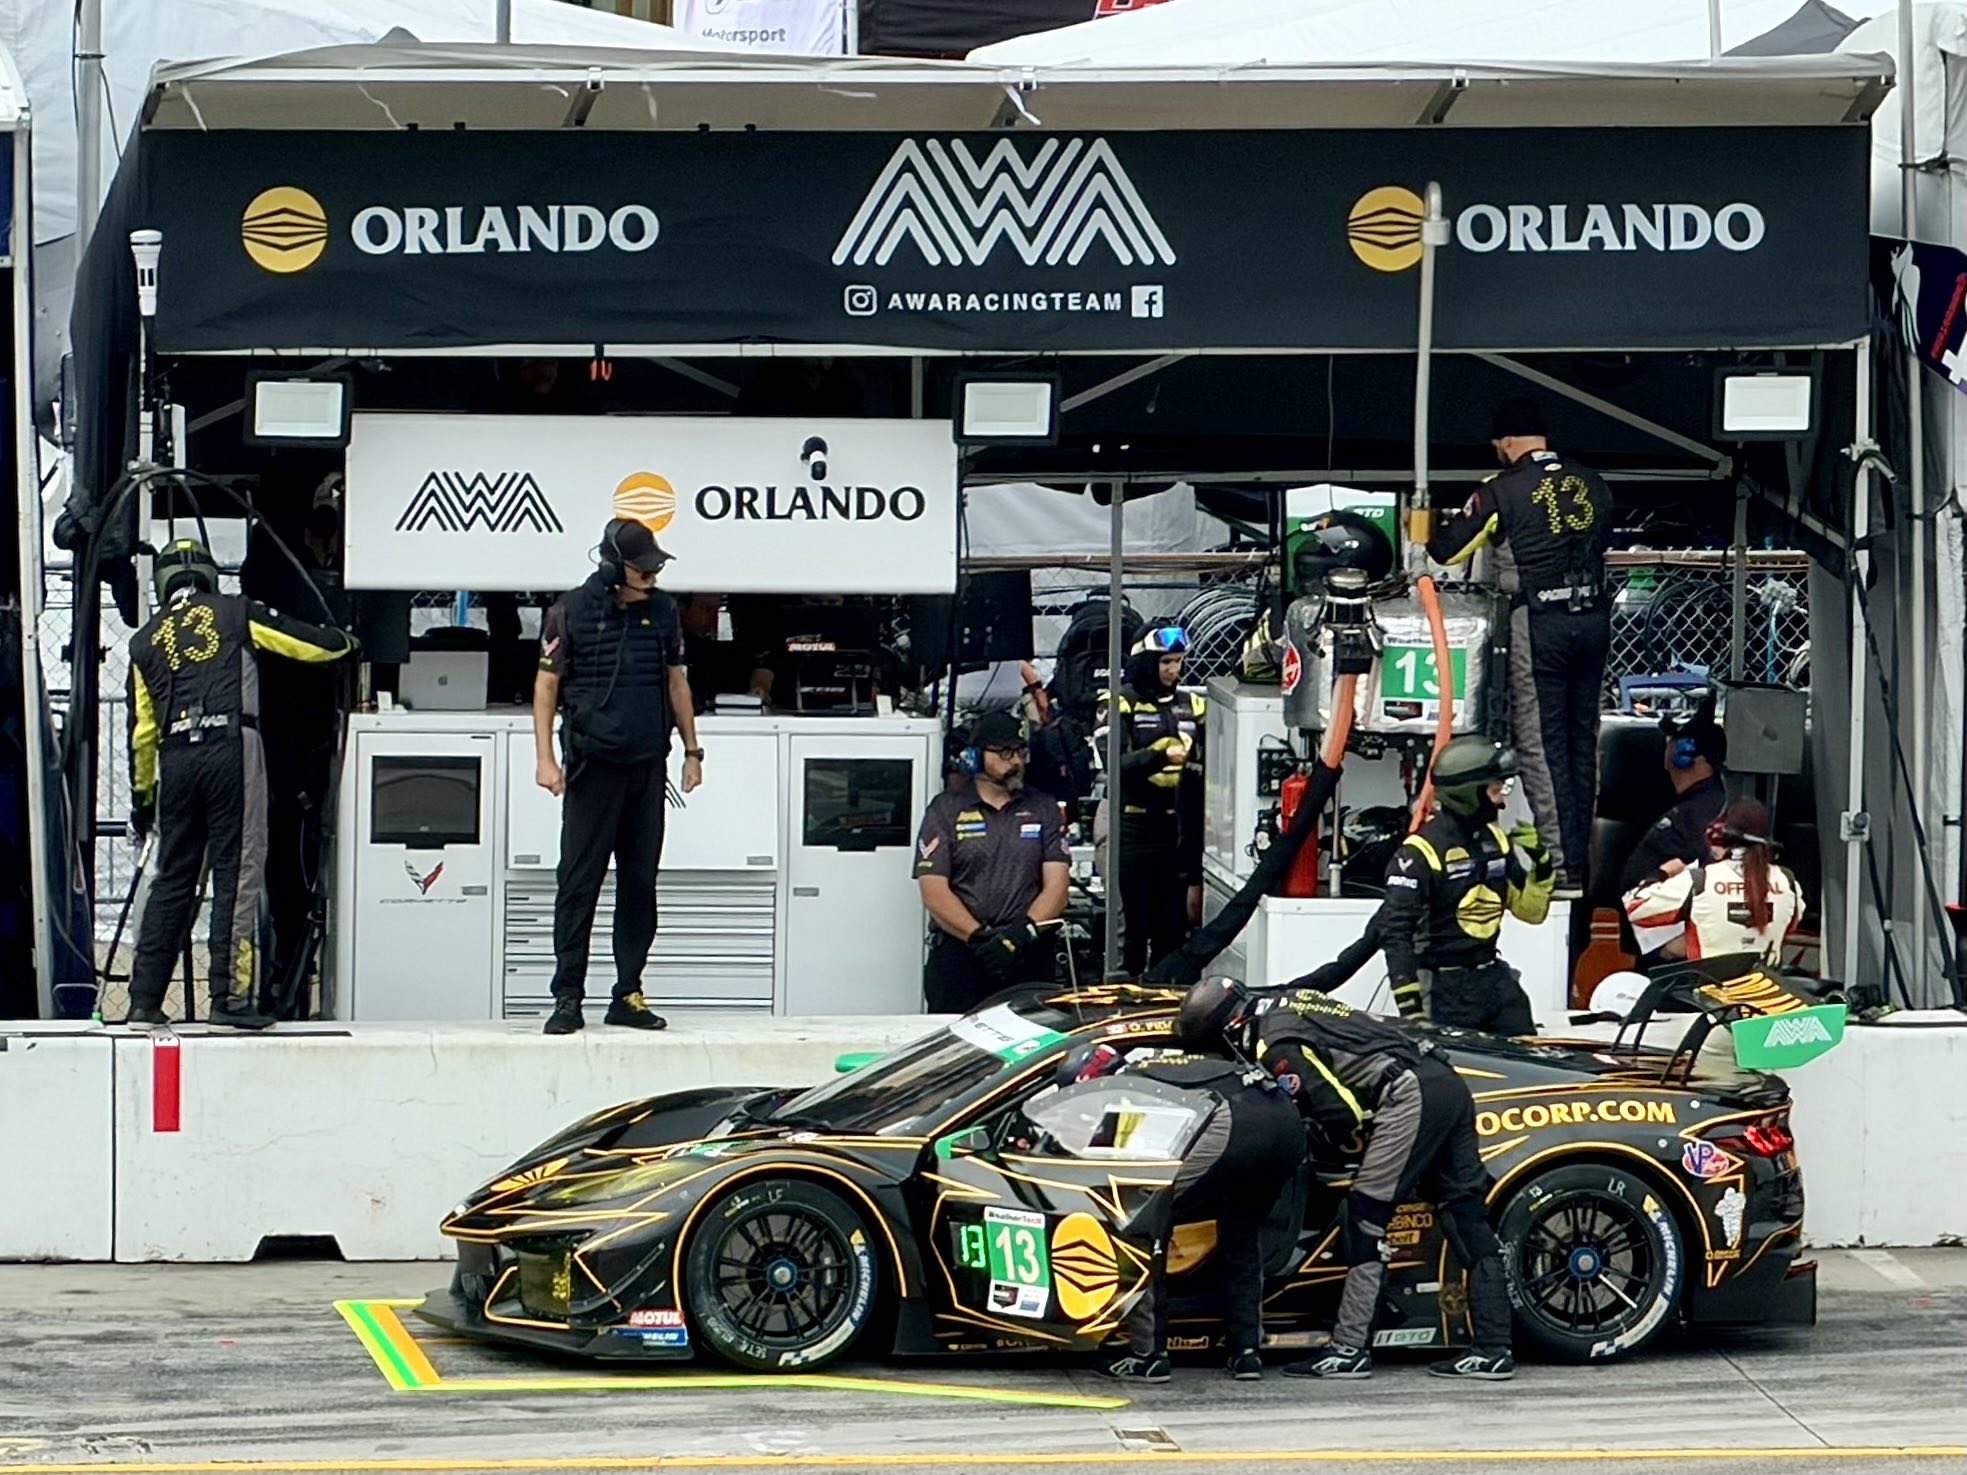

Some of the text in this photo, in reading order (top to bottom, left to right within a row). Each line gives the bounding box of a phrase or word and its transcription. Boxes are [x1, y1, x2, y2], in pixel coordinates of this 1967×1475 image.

[350, 204, 661, 256] ORLANDO
[1455, 201, 1767, 254] ORLANDO
[887, 292, 1123, 312] AWARACINGTEAM
[694, 485, 926, 522] ORLANDO
[1531, 475, 1594, 534] 13
[151, 605, 220, 671] 13
[1475, 1099, 1677, 1136] OCORP.COM
[1607, 1177, 1627, 1197] LR
[960, 1224, 986, 1268] 13
[995, 1225, 1041, 1284] 13
[1658, 1220, 1679, 1300] MICHELIN
[854, 1253, 873, 1323] MICHELIN
[628, 1311, 684, 1326] MOTUL
